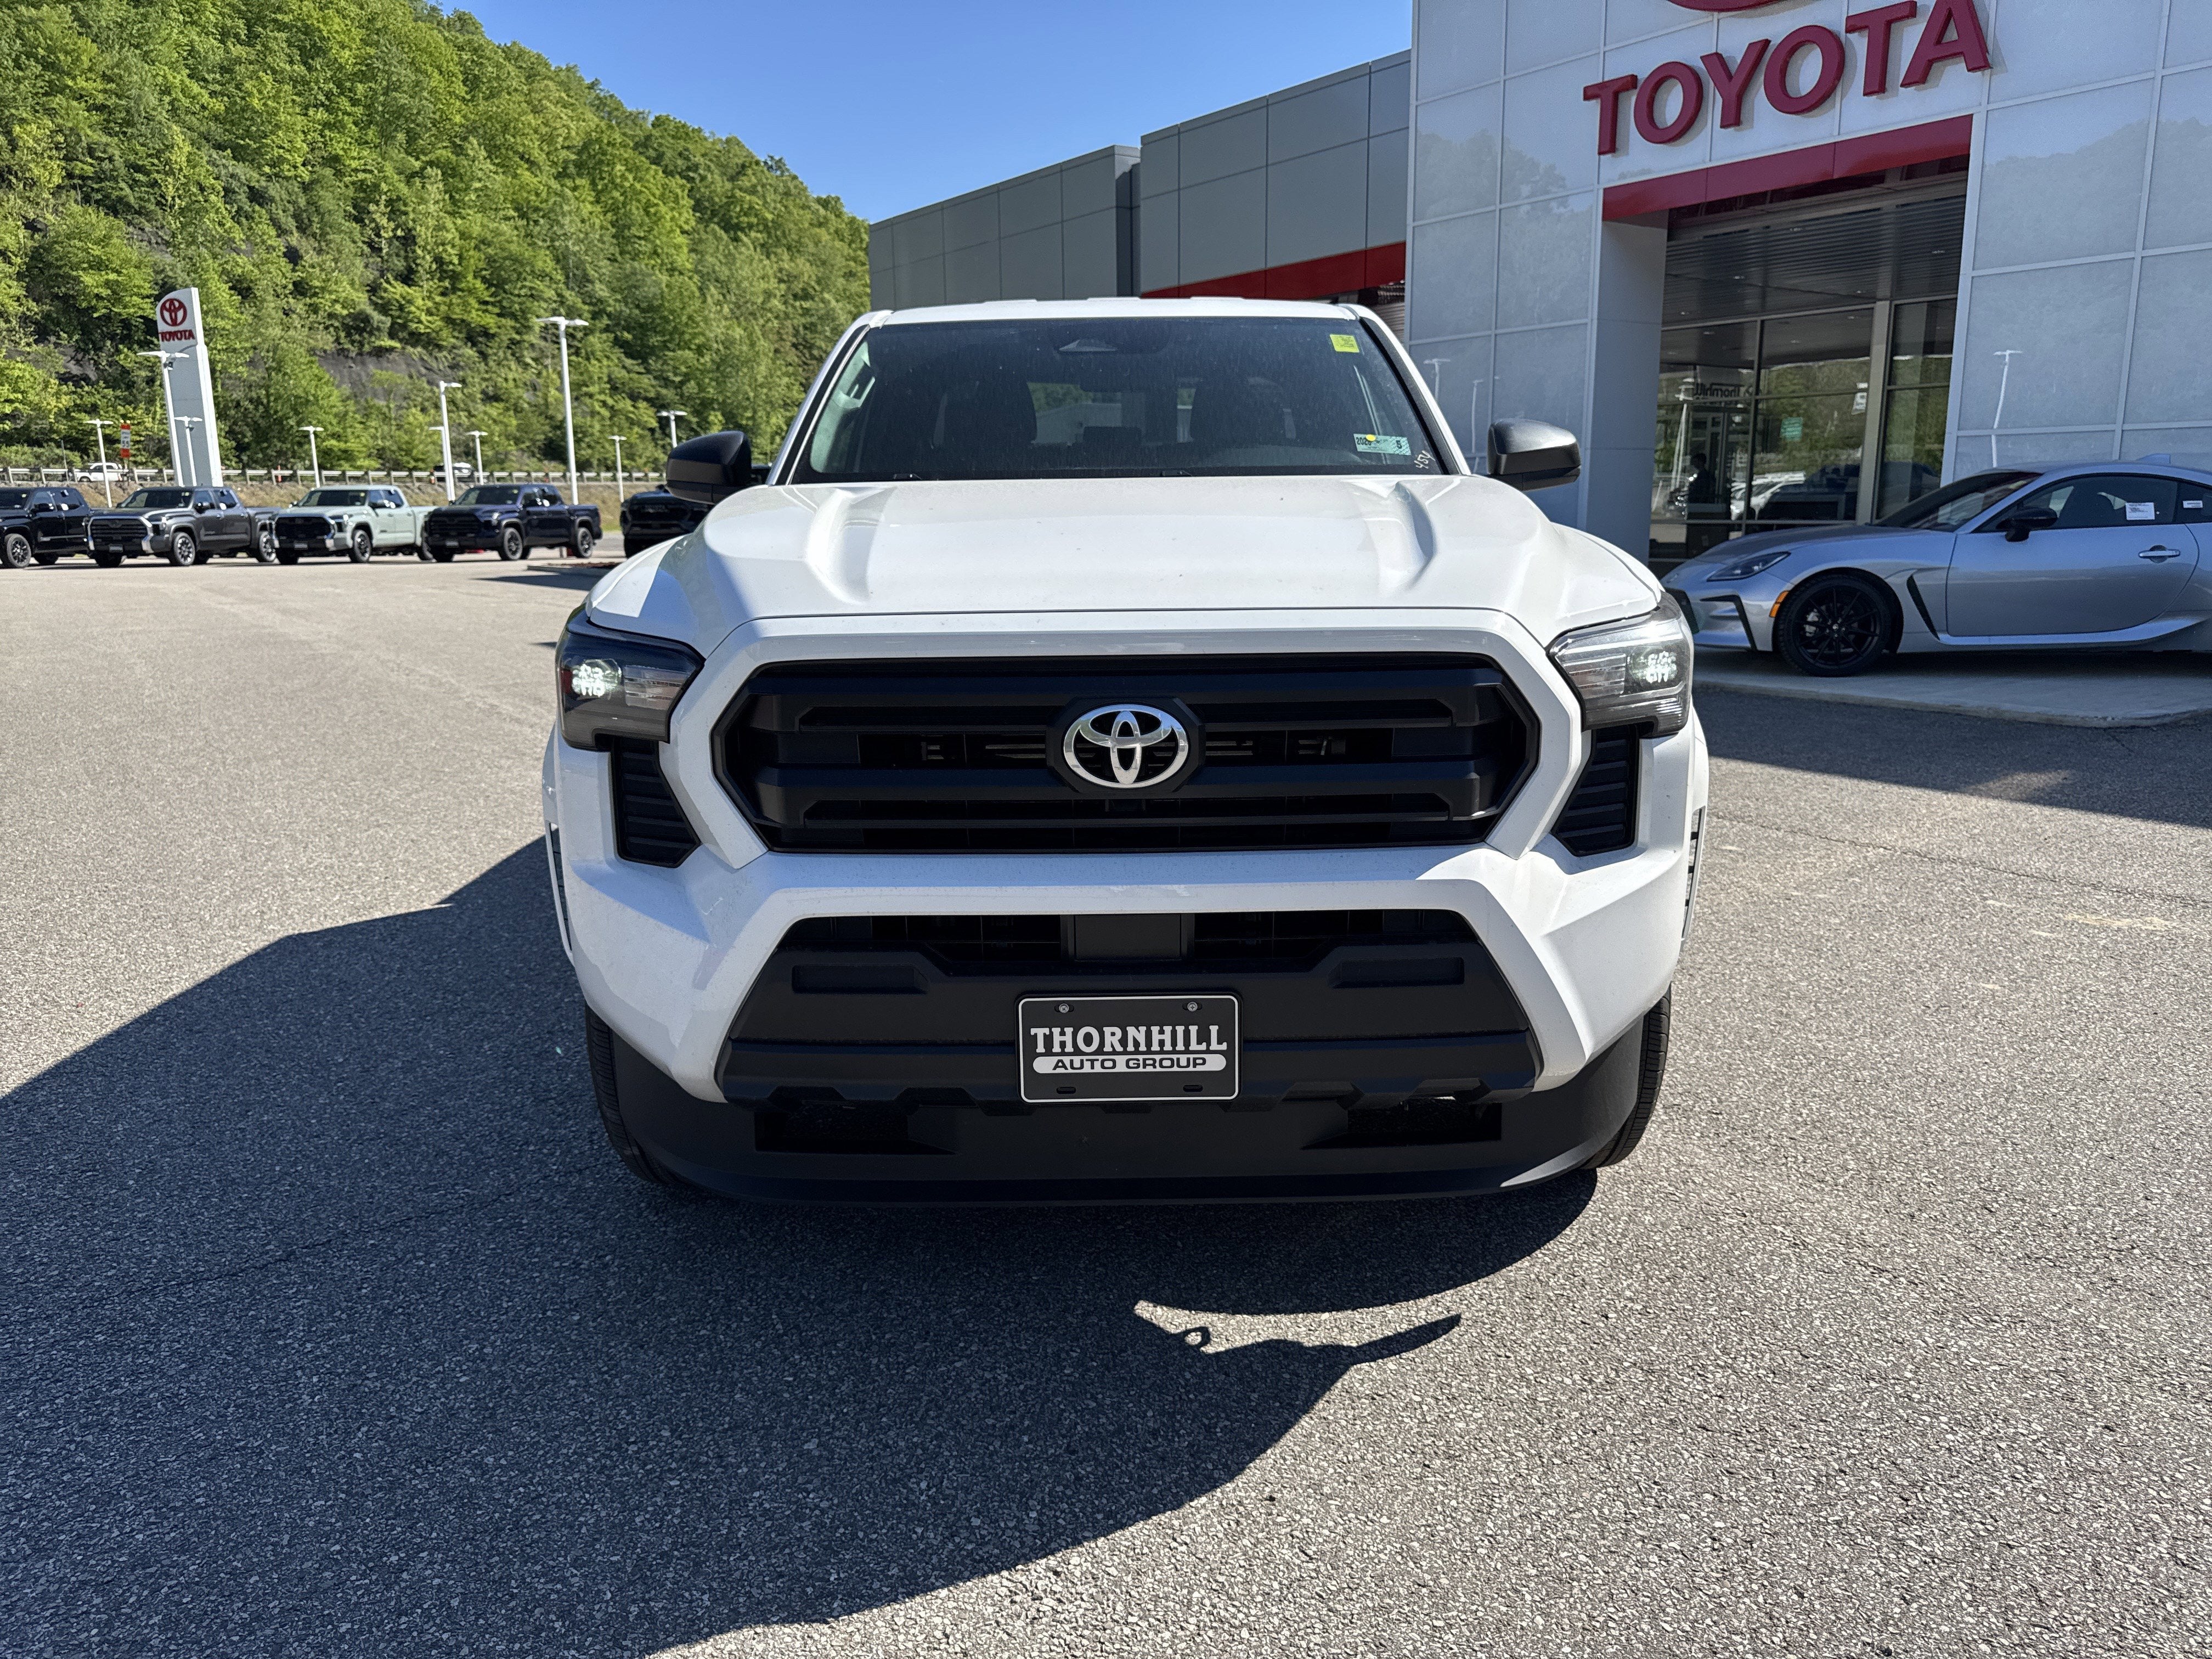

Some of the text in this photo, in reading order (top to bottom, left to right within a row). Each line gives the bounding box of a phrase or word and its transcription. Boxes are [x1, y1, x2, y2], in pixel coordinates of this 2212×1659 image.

[1583, 0, 1991, 155] TOYOTA
[159, 329, 195, 342] TOYOTA
[1396, 440, 1402, 449] 5
[1030, 1025, 1227, 1053] THORNHILL
[1052, 1057, 1207, 1071] AUTO GROUP
